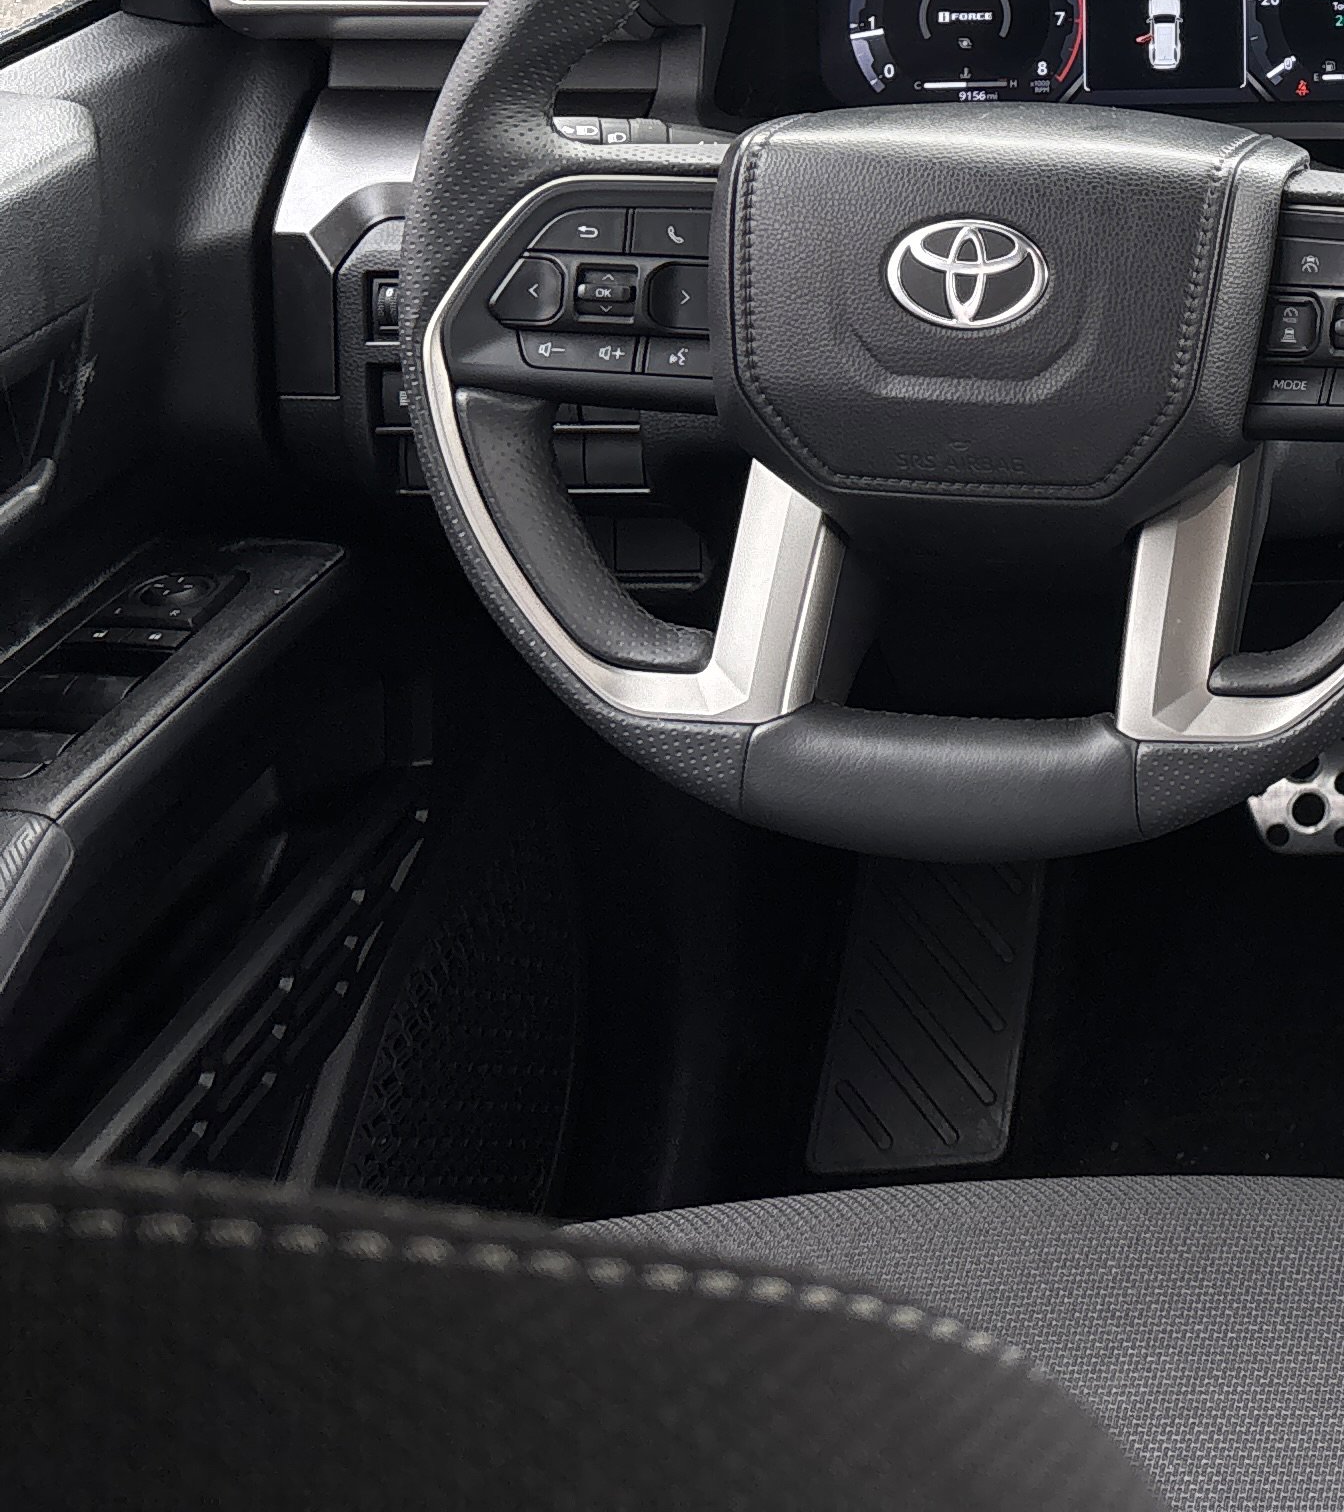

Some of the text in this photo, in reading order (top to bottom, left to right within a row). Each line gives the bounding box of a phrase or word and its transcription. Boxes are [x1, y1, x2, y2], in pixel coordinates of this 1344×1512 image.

[1054, 11, 1066, 26] 7
[883, 64, 895, 79] 0
[1037, 61, 1048, 75] 8
[595, 287, 612, 298] OK
[1272, 379, 1308, 391] MODE
